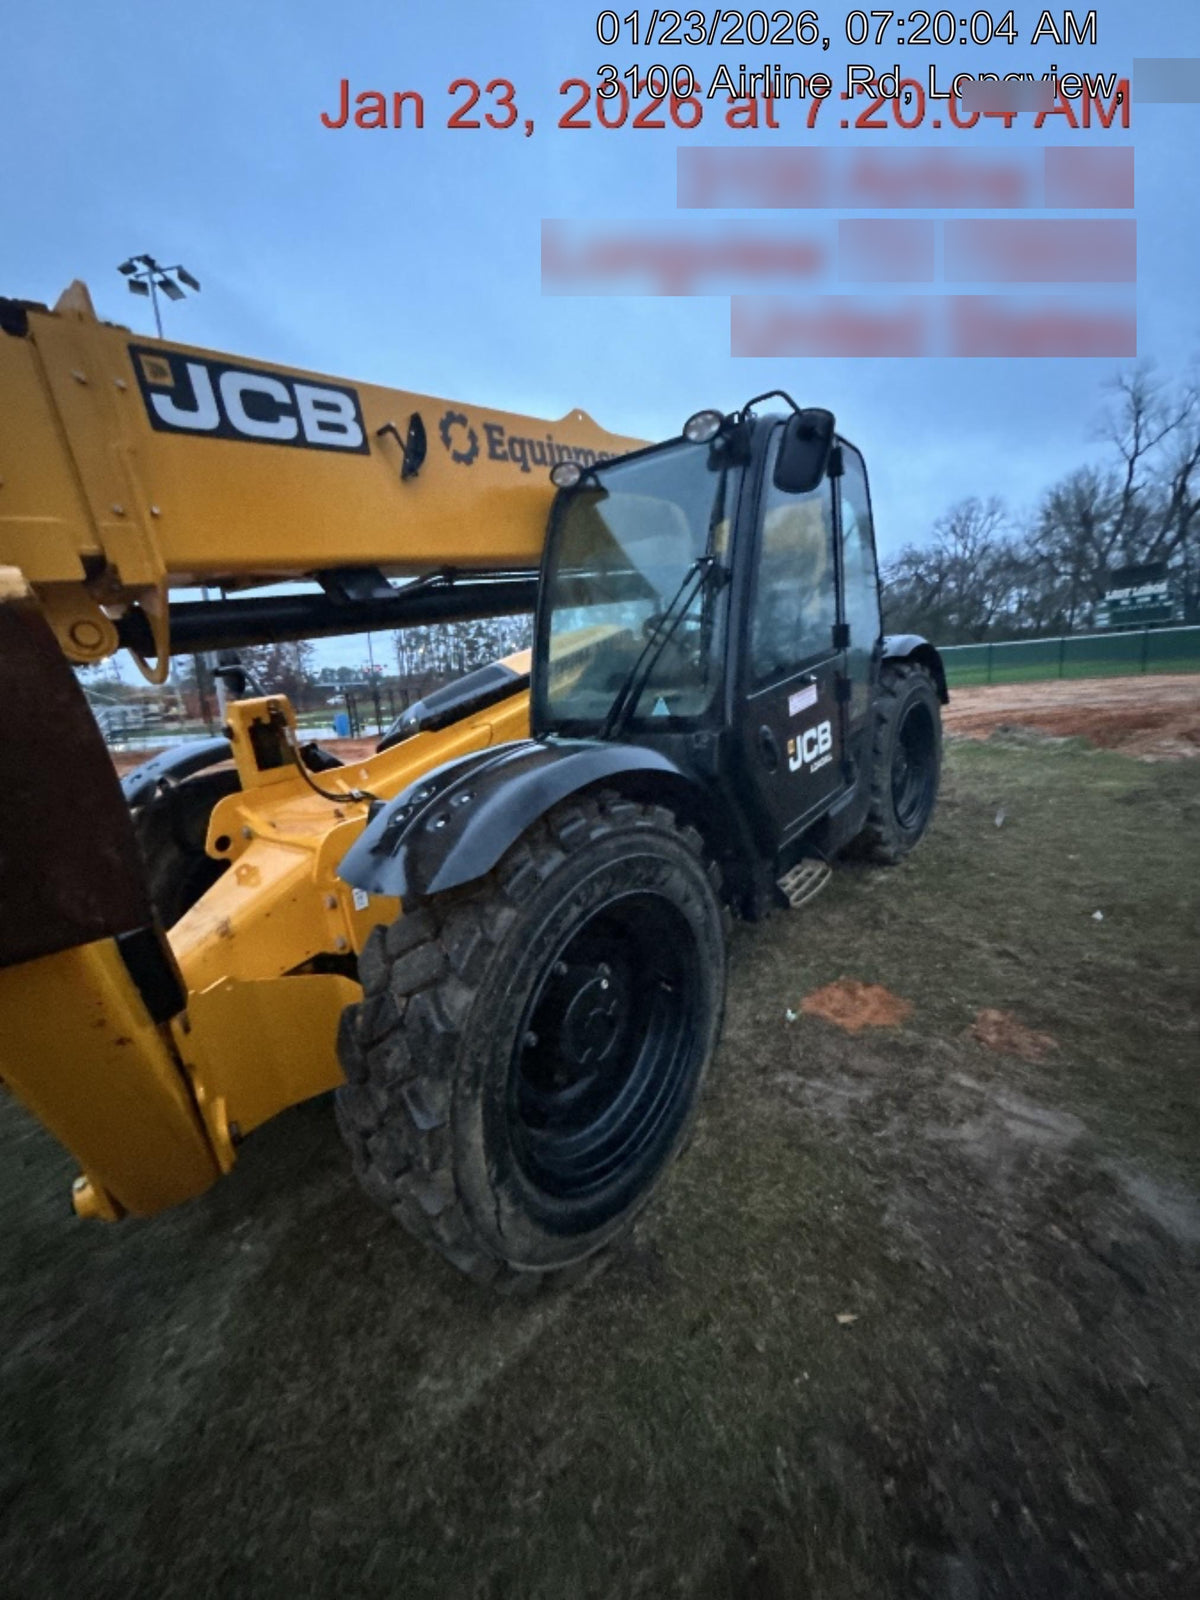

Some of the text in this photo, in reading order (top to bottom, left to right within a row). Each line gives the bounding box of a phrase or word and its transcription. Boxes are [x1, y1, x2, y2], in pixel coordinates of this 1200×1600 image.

[149, 362, 364, 448] JCB
[483, 422, 632, 473] Equipm
[788, 719, 833, 773] JCB
